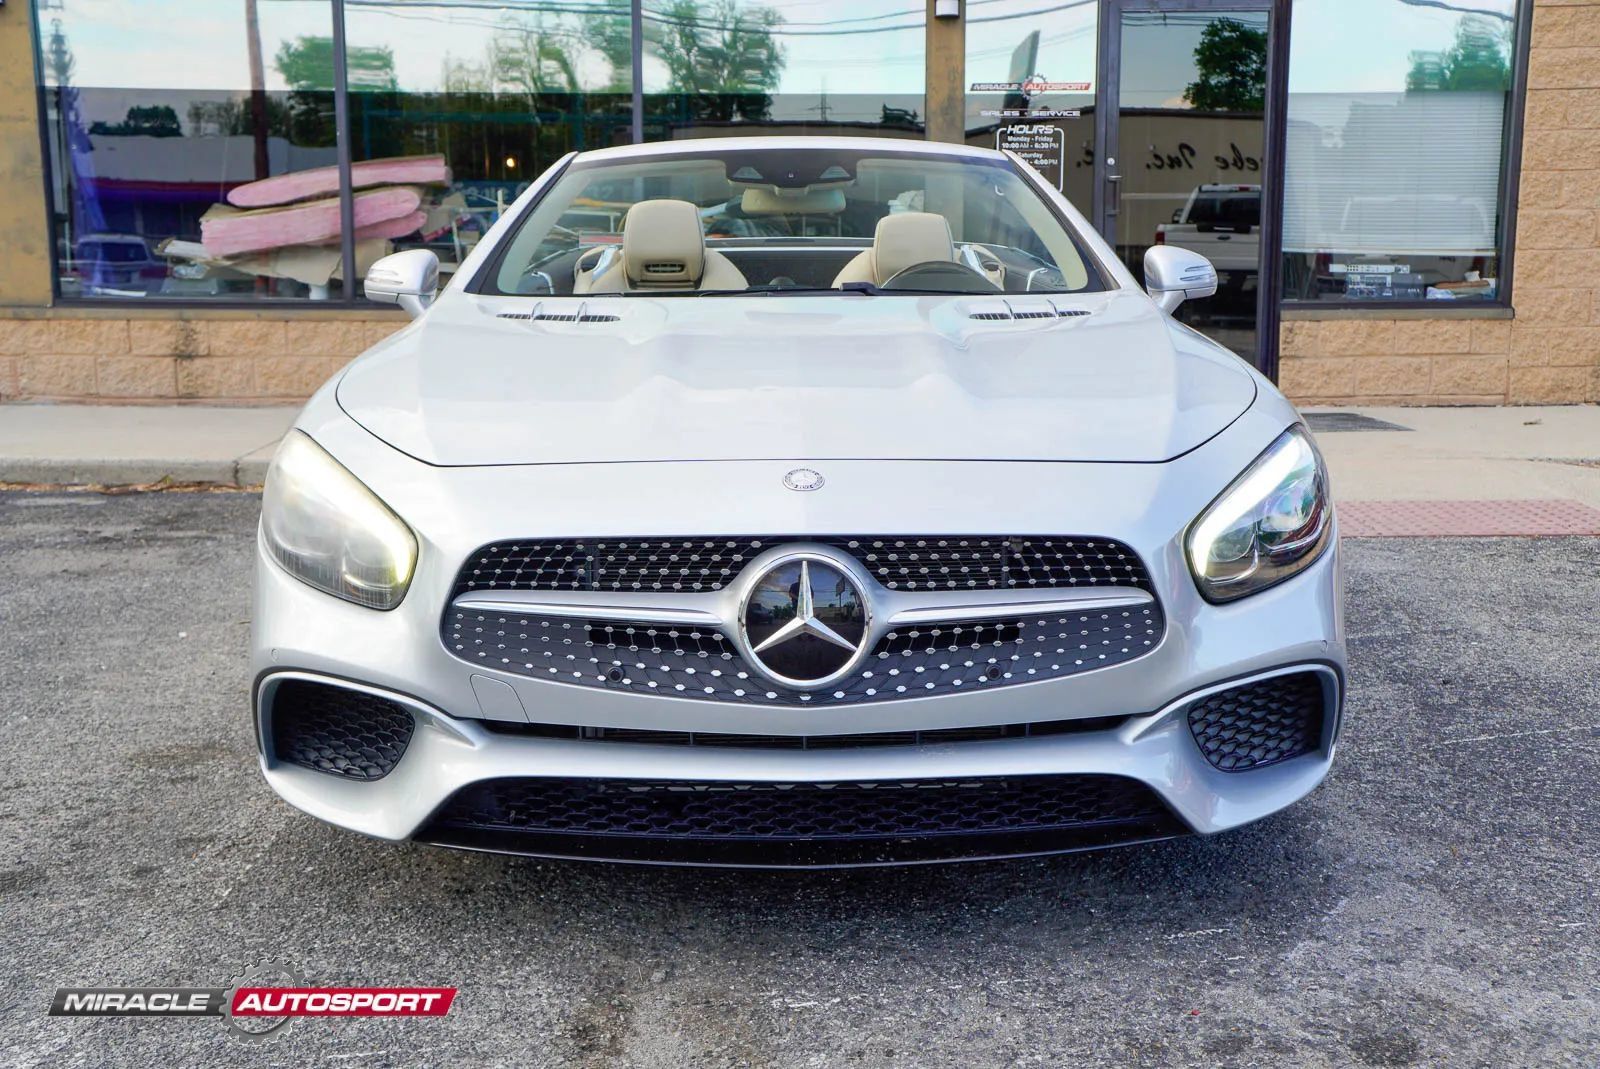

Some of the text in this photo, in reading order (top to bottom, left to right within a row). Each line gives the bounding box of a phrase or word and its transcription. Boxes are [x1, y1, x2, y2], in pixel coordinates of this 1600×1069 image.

[1007, 124, 1055, 134] HOURS
[1007, 135, 1030, 143] Monday
[1034, 135, 1053, 143] Friday
